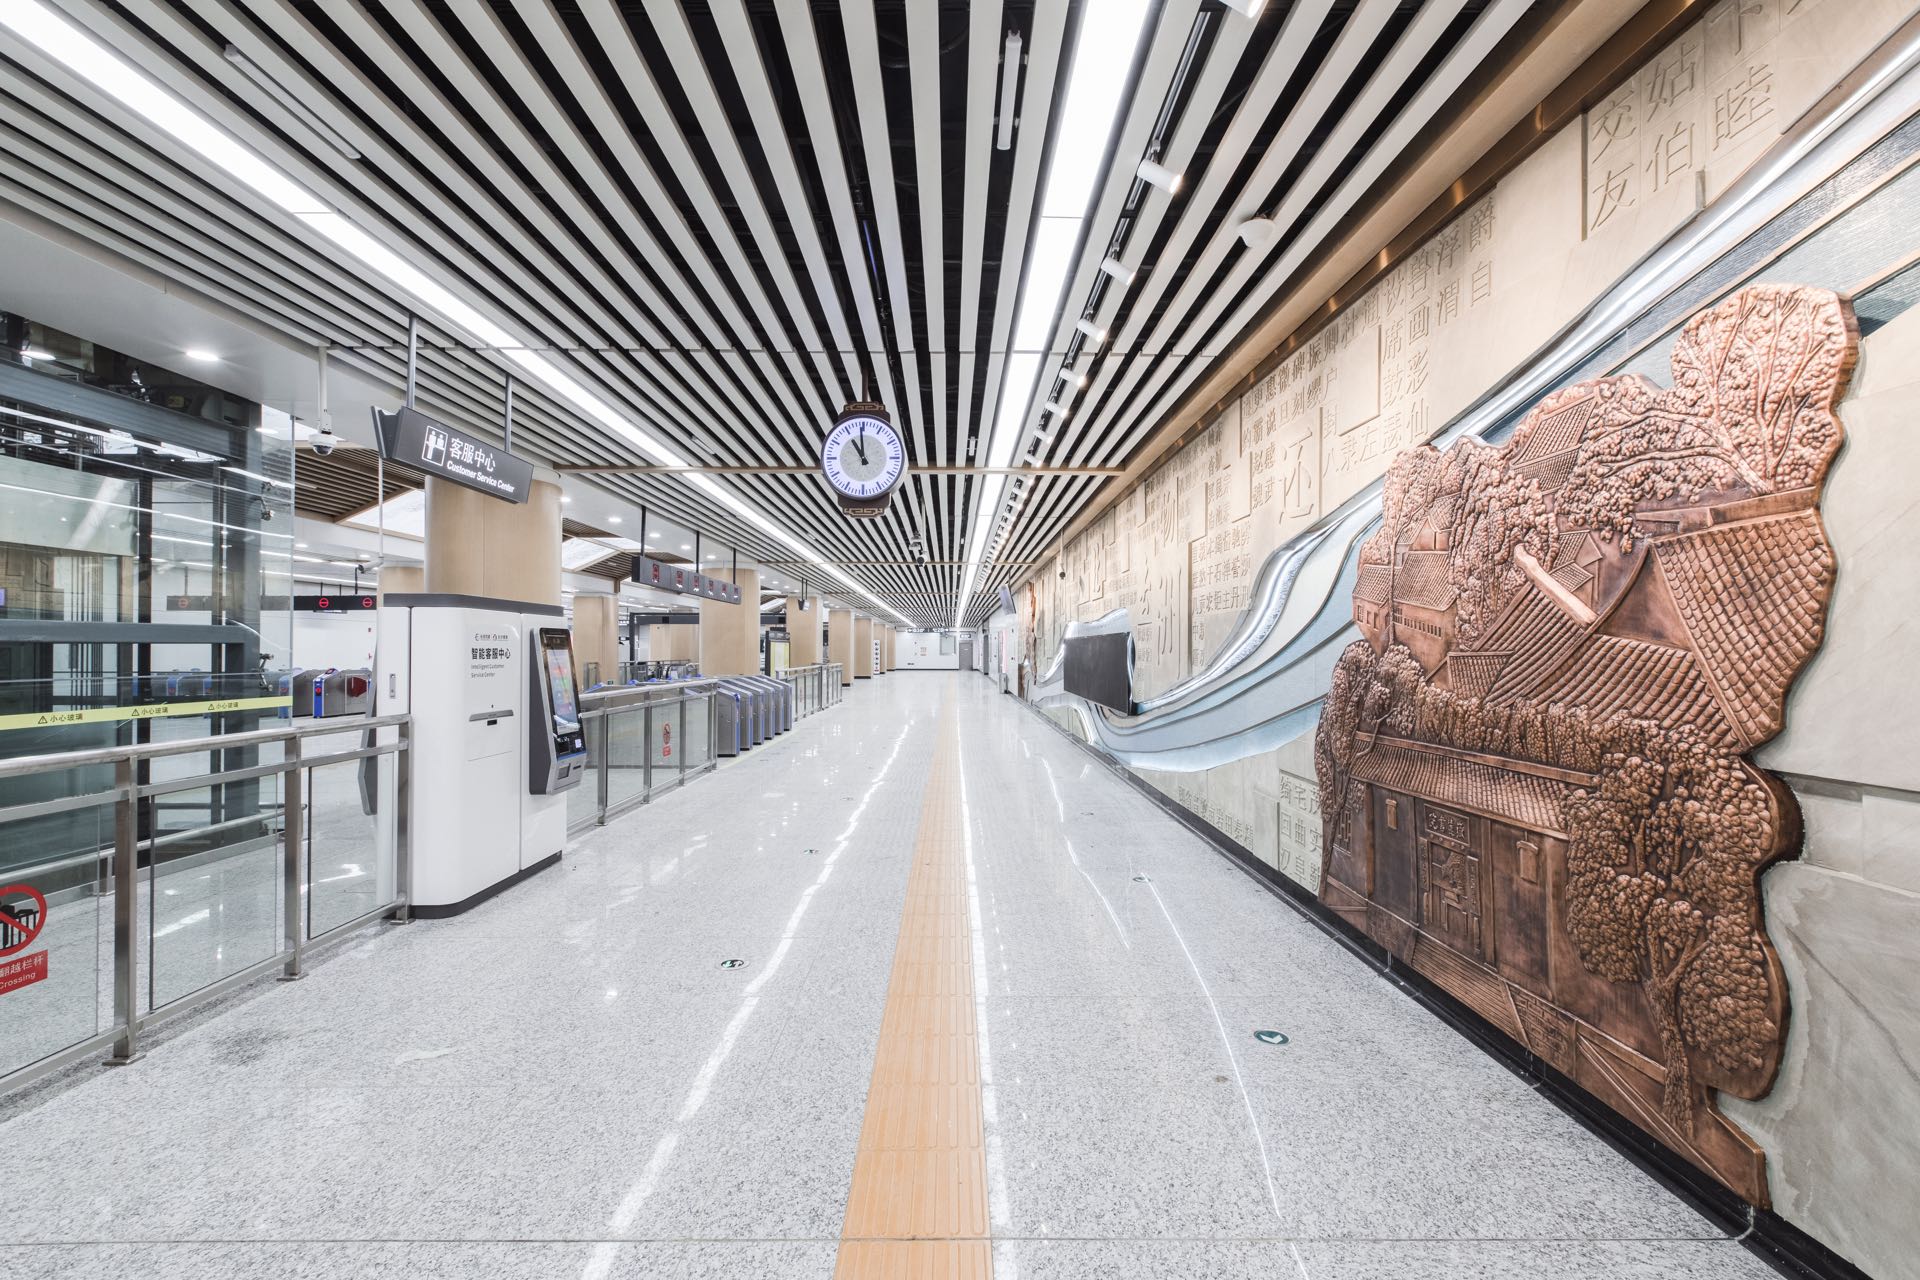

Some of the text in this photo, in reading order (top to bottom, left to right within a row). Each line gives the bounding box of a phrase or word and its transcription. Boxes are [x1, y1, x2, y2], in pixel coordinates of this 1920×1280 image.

[449, 437, 496, 473] 客服中心
[446, 459, 516, 494] Customer Service Center
[471, 647, 511, 660] 智能客服中心
[141, 706, 169, 716] 小心玻璃
[216, 701, 239, 710] 小心玻璃
[50, 713, 83, 723] 小心玻璃
[0, 971, 37, 990] Crossing
